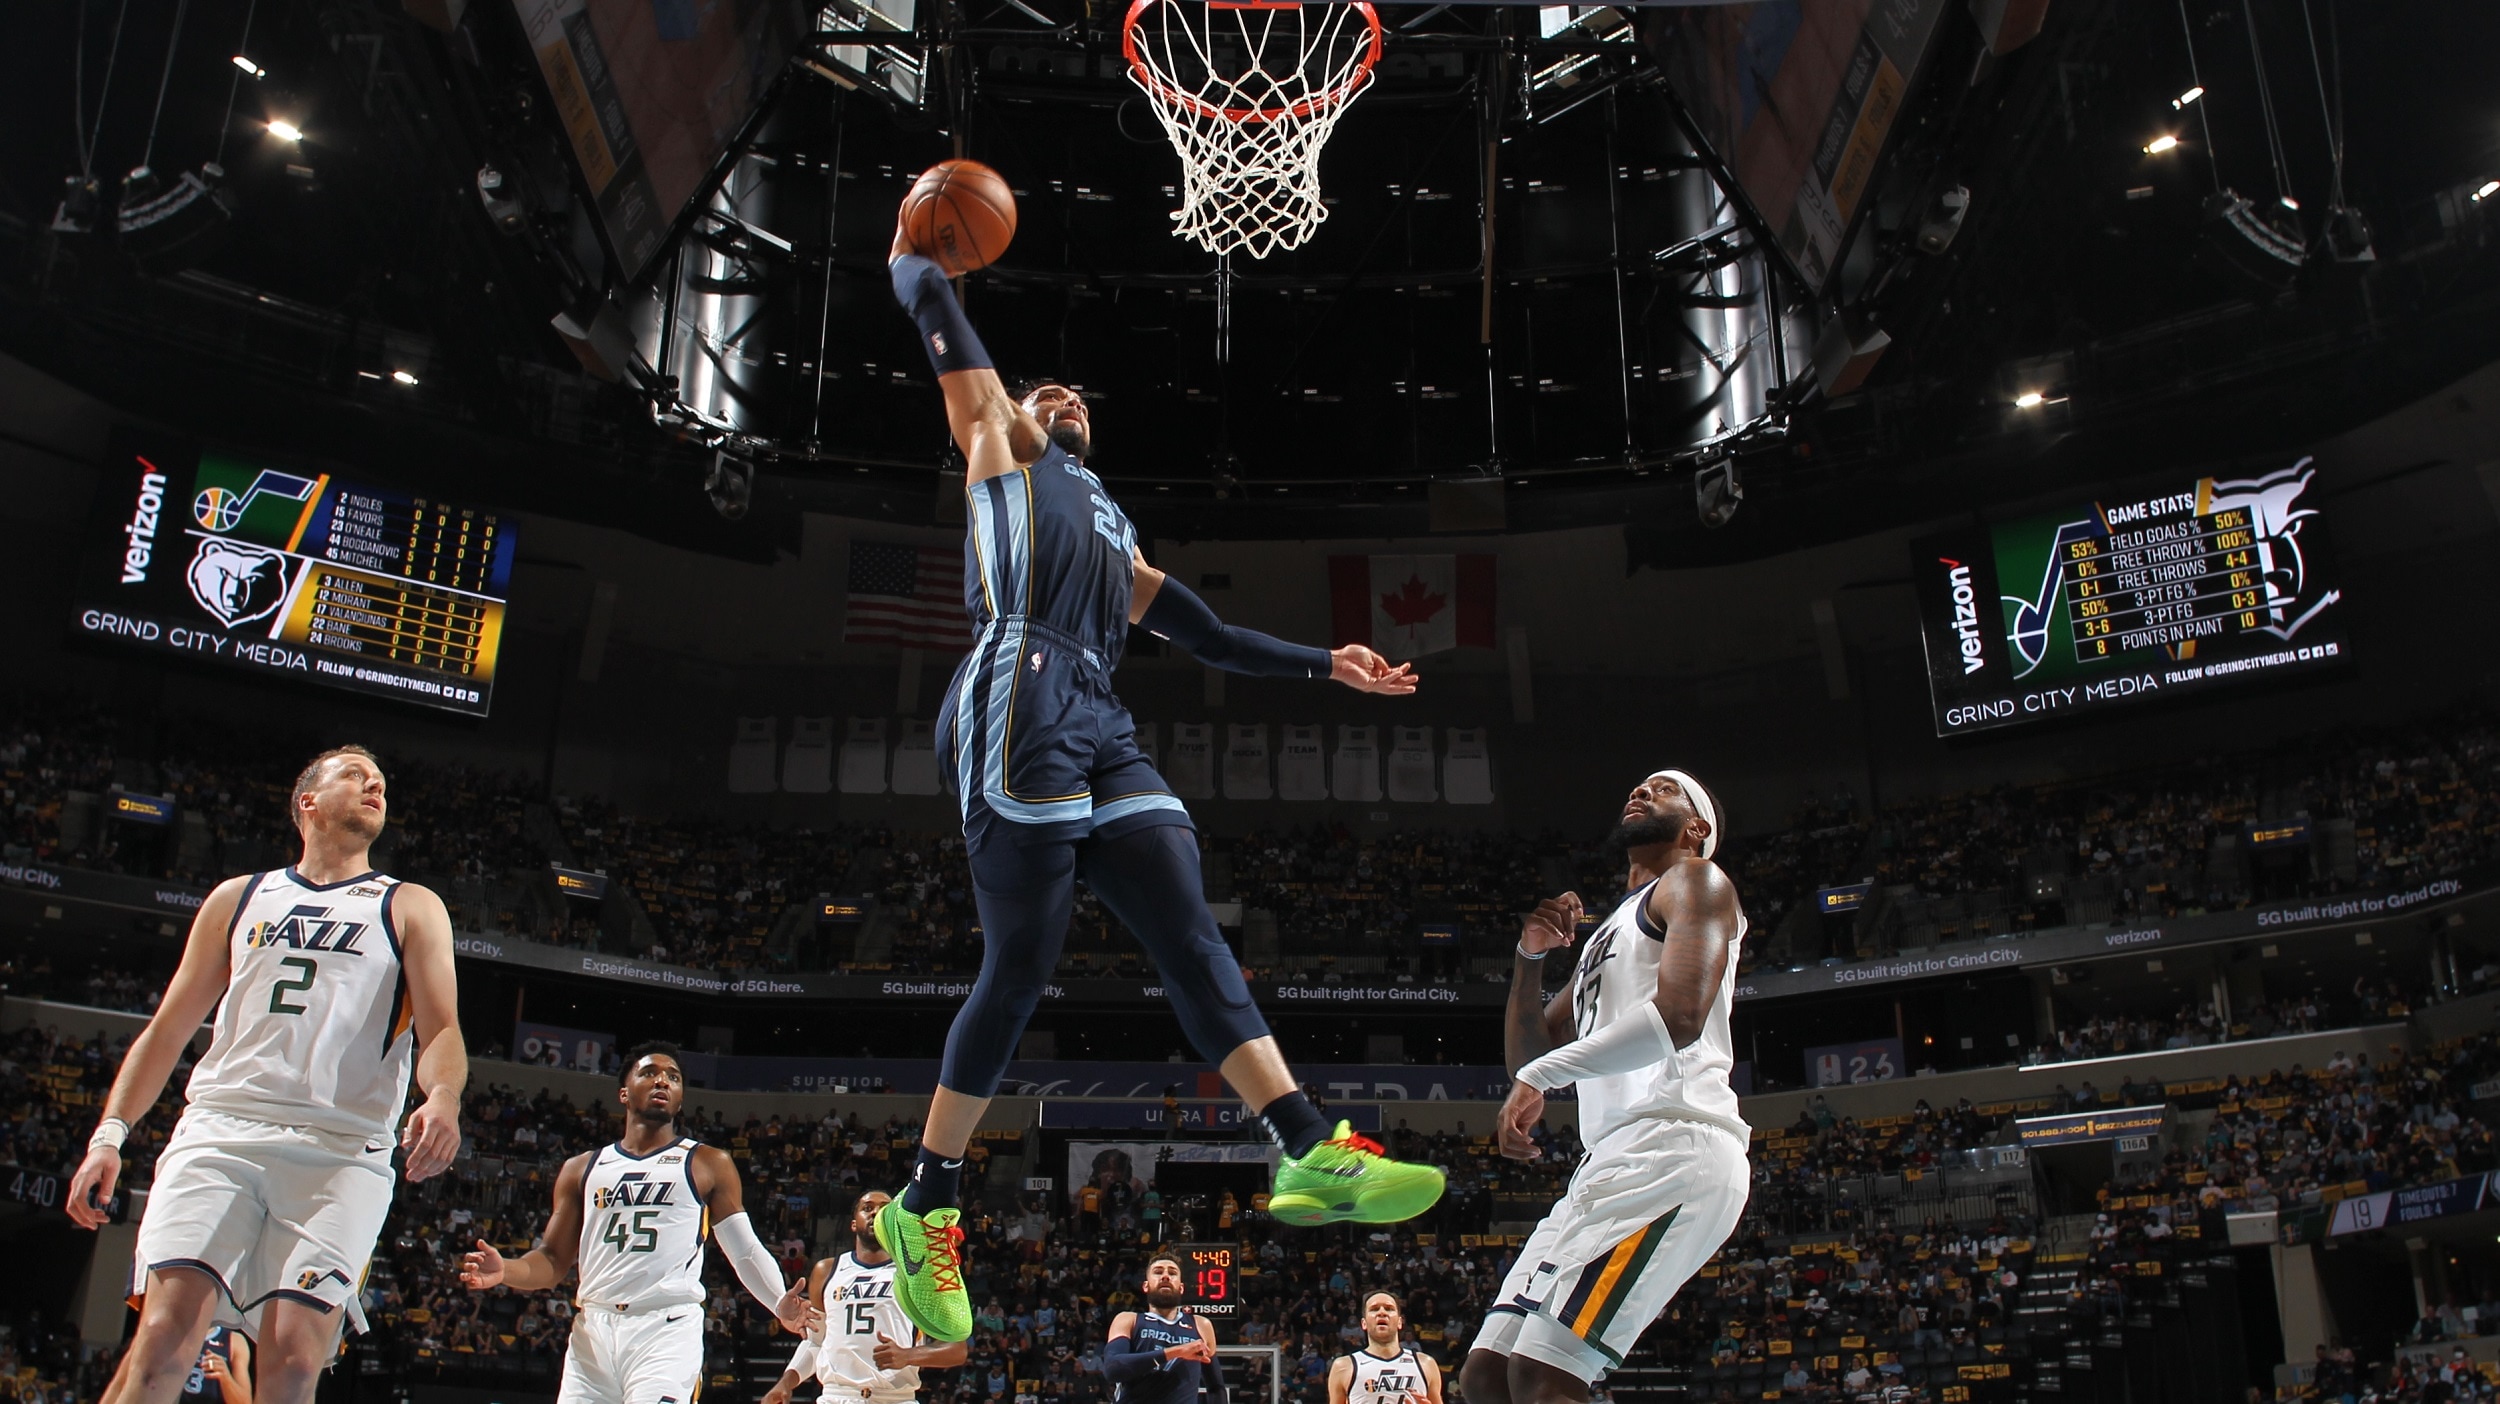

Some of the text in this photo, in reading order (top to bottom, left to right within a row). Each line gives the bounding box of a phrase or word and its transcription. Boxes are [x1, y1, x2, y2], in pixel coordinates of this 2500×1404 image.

[340, 492, 348, 504] 2
[350, 494, 383, 511] INGLES
[2107, 493, 2194, 525] GAME STATS
[334, 506, 346, 518] 15
[348, 508, 384, 525] FAVORS
[121, 473, 167, 584] verizon
[331, 519, 343, 532] 23
[345, 522, 383, 541] O'NEALE
[2071, 511, 2244, 558] 53% FIELD GOALS % 50%
[326, 547, 338, 560] 45
[340, 550, 384, 570] MITCHELL
[328, 533, 341, 546] 44
[342, 536, 400, 559] BOGDANOVIC
[2078, 530, 2250, 578] 0% FREE THROW % 100%
[324, 575, 364, 593] 3 ALLEN
[2080, 551, 2248, 597] 0-1 FREE THROWS 4-4
[319, 589, 371, 609] 12 MORANT
[2081, 571, 2251, 617] 50% 3-PT FG % 0%
[313, 617, 352, 634] 22 BANE
[317, 603, 387, 628] 17 VALANCIUNAS
[1949, 566, 1984, 675] verizon
[2085, 591, 2256, 636] 3-6 3-PT FG 0-3
[82, 609, 308, 671] GRIND CITY MEDIA
[310, 631, 363, 652] 24 BROOKS
[2096, 612, 2255, 655] 8 POINTS IN PAINT 10
[317, 660, 441, 695] FOLLOW @GRINDCITYMEDIA
[2165, 650, 2296, 684] FOLLOW @GRINDCITYMEDIA
[1946, 674, 2158, 726] GRIND CITY MEDIA
[0, 861, 61, 888] ind City.
[155, 890, 206, 908] verizo
[2257, 878, 2463, 926] 5G built right for Grind City.
[471, 940, 503, 958] City.
[2105, 928, 2161, 947] verizon
[582, 958, 804, 993] Experience the power of 5G here.
[1834, 948, 2023, 983] 5G built right for Grind City.
[269, 956, 317, 1015] 2
[882, 982, 970, 998] 5G built right
[1040, 984, 1065, 998] ity.
[1277, 986, 1459, 1002] 5G built right for Grind City.
[1733, 983, 1758, 997] ere.
[793, 1076, 883, 1087] SUPERIOR
[2003, 1151, 2019, 1162] 117
[2121, 1138, 2146, 1150] 116A
[9, 1171, 57, 1207] 4:40
[1032, 1179, 1047, 1189] 101
[2398, 1186, 2450, 1203] TIMEOUTS:
[2352, 1199, 2372, 1229] 19
[2400, 1205, 2433, 1222] FOULS:
[604, 1211, 661, 1253] 45
[1193, 1250, 1230, 1267] 4:40
[1198, 1269, 1227, 1300] 19
[845, 1303, 875, 1335] 15
[1192, 1304, 1235, 1314] TISSOT
